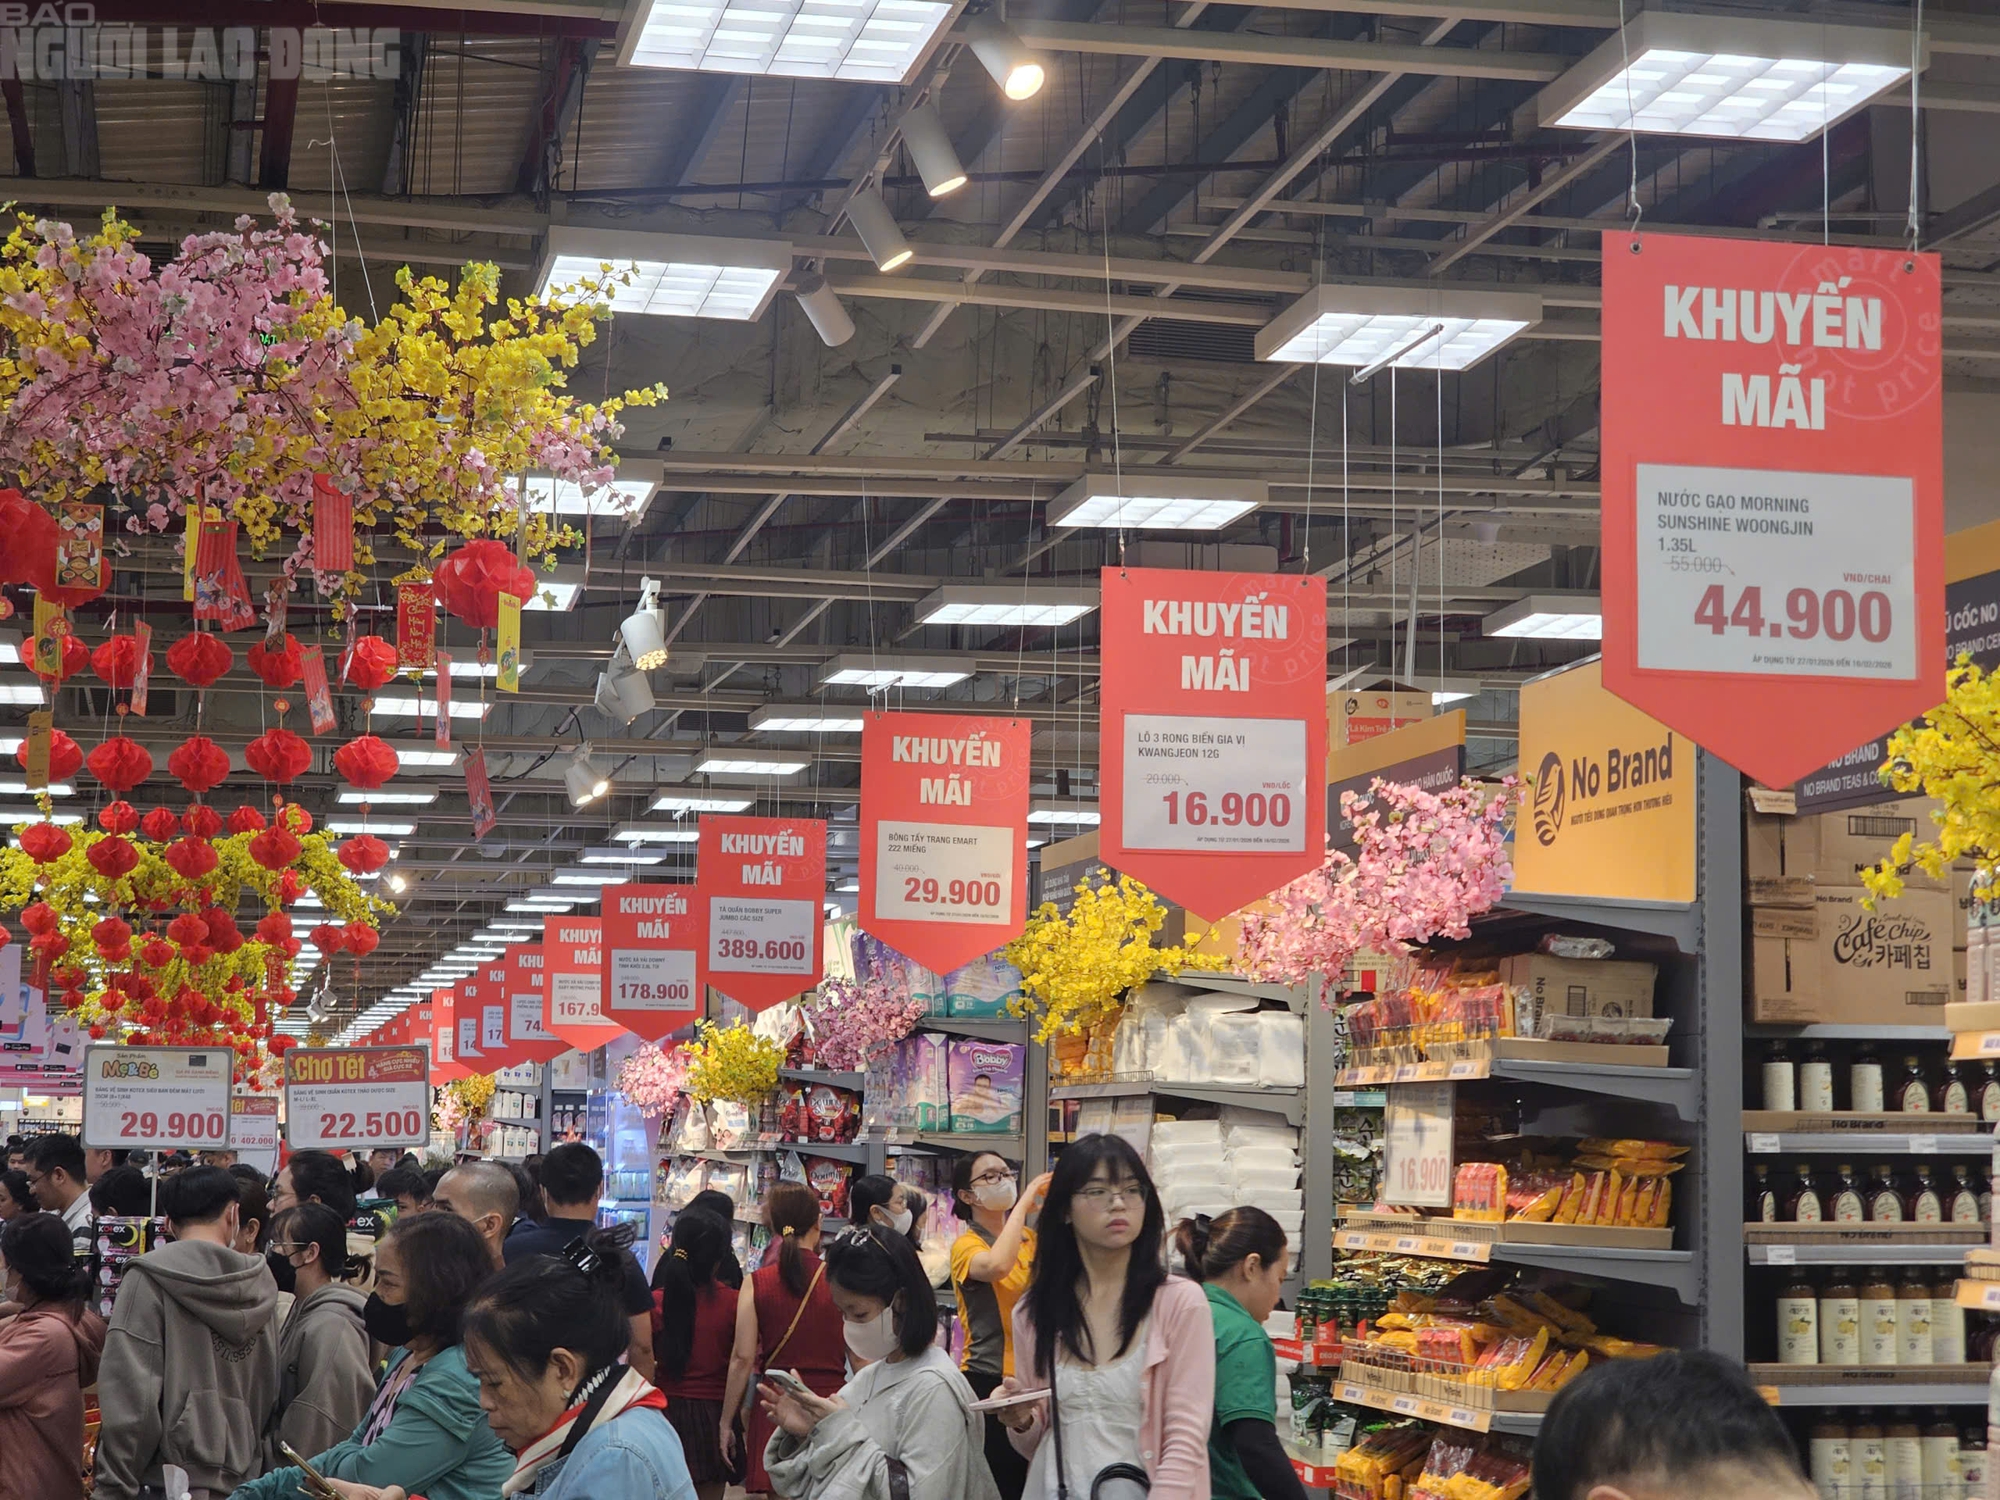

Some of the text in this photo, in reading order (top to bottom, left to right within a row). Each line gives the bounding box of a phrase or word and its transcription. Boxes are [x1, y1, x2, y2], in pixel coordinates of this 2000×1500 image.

[1663, 276, 1882, 350] KHUYẾN
[1721, 363, 1826, 431] MÃI
[1657, 488, 1810, 514] NƯỚC GẠO MORNING
[1657, 514, 1814, 536] SUNSHINE WOONGJIN
[1658, 537, 1698, 553] 1.35L
[1670, 555, 1722, 573] 55.000
[1843, 572, 1892, 585] VND/CHAI
[1143, 591, 1288, 640] KHUYẾN
[1694, 584, 1893, 643] 44.900
[1980, 602, 1998, 623] NO
[1181, 648, 1250, 692] MÃI
[892, 731, 1001, 767] KHUYẾN
[1153, 733, 1160, 743] 3
[1162, 733, 1189, 744] RONG
[1217, 734, 1233, 745] GIA
[1138, 747, 1220, 759] KWANGJEON 12G
[1572, 731, 1673, 802] No Brand
[920, 773, 972, 806] MÃI
[1803, 773, 1869, 797] NO BRAND TEAS &
[1162, 791, 1291, 828] 16.900
[720, 829, 804, 856] KHUYẾN
[888, 844, 902, 852] 222
[927, 836, 951, 845] TRANG
[953, 837, 978, 846] EMART
[742, 860, 782, 886] MÃI
[904, 876, 1001, 907] 29.900
[619, 892, 687, 915] KHUYẾN
[637, 919, 670, 939] MÃI
[1888, 921, 1932, 942] Chip
[718, 938, 805, 961] 389.600
[618, 983, 689, 1000] 178.900
[1536, 977, 1545, 994] No
[295, 1052, 366, 1083] Chợ Tết
[975, 1053, 1008, 1066] Bobby
[120, 1111, 224, 1139] 29.900
[320, 1111, 421, 1139] 22.500
[1850, 1120, 1885, 1129] Brand
[241, 1137, 274, 1145] 402.000
[1399, 1157, 1447, 1192] 16.900
